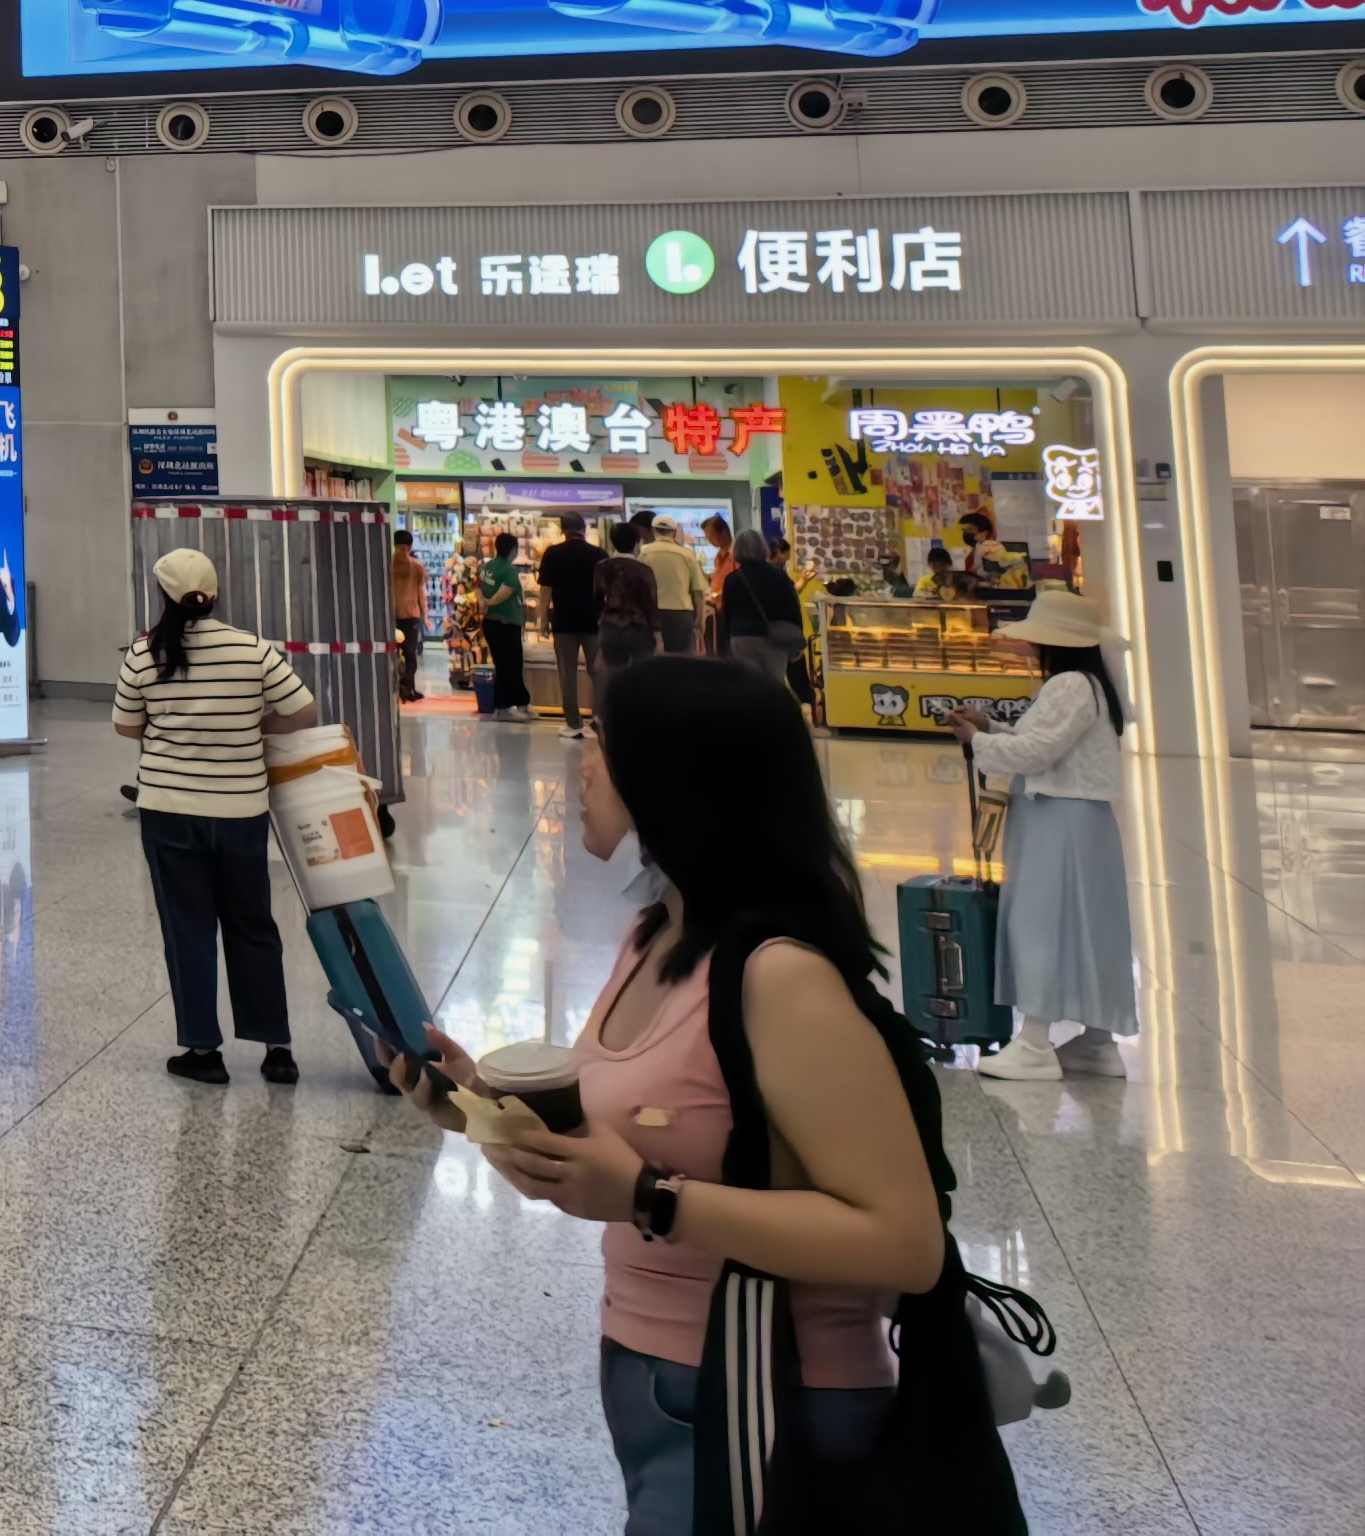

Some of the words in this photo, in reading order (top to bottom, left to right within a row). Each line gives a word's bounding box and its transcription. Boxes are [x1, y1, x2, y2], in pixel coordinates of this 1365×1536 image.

[480, 253, 619, 296] 乐途瑞
[737, 227, 962, 294] 便利店
[412, 401, 786, 455] 粤港澳台特产
[849, 409, 1036, 445] 周黑鸭
